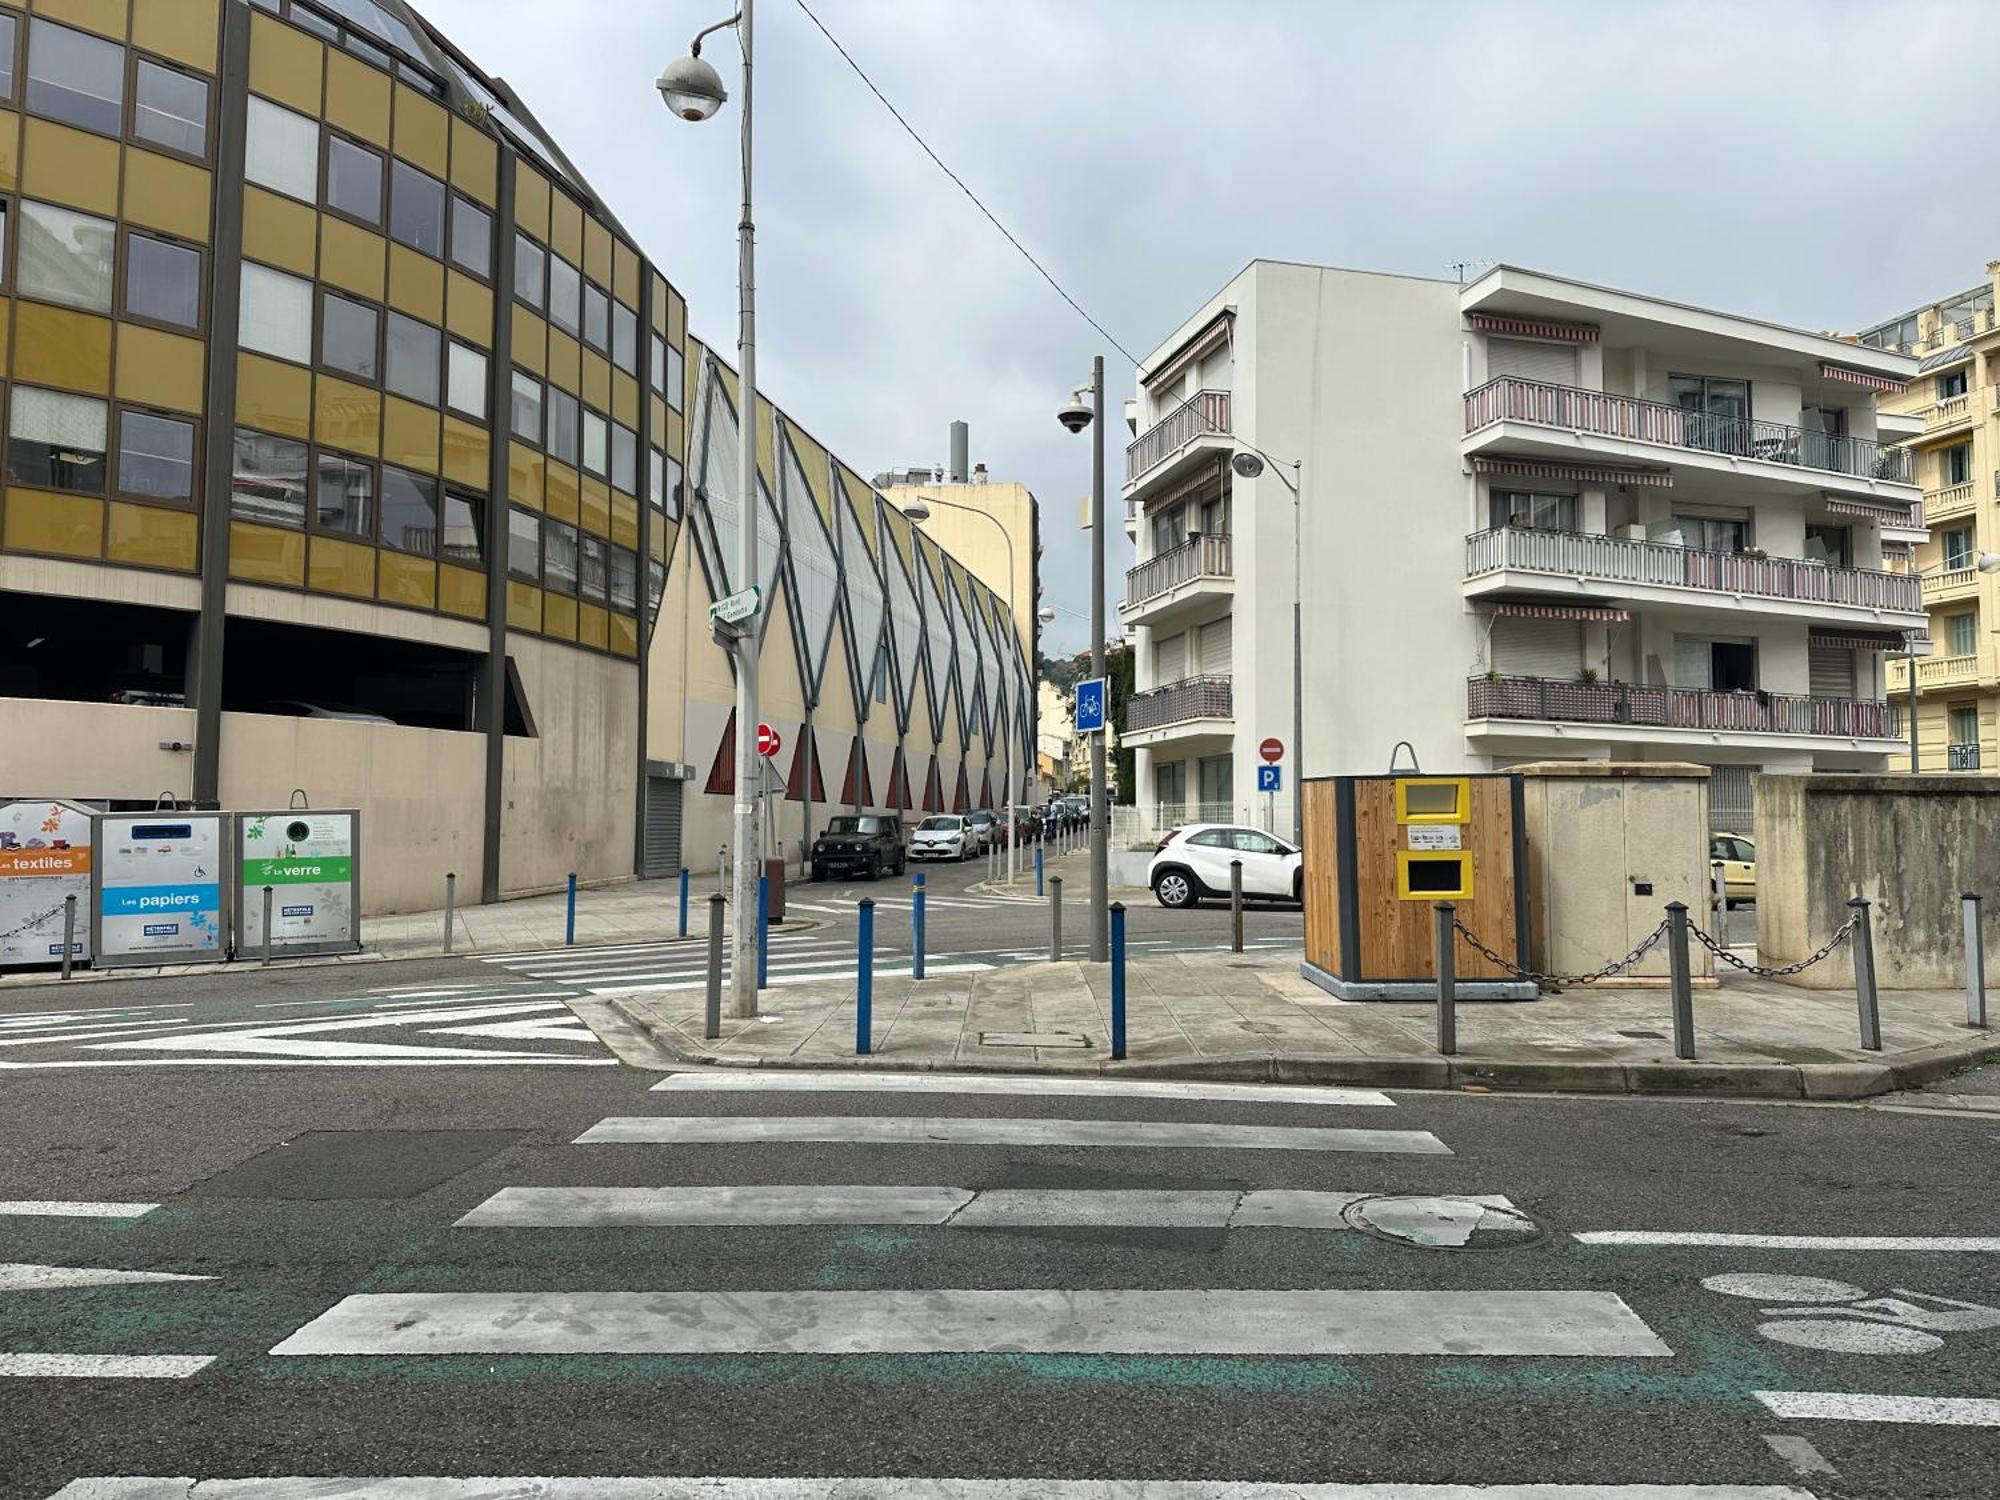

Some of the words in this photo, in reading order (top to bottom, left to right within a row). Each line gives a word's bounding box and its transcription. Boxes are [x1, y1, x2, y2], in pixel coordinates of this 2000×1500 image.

[1263, 770, 1275, 787] P
[13, 857, 73, 869] textiles
[283, 866, 321, 876] verre
[140, 893, 200, 909] papiers
